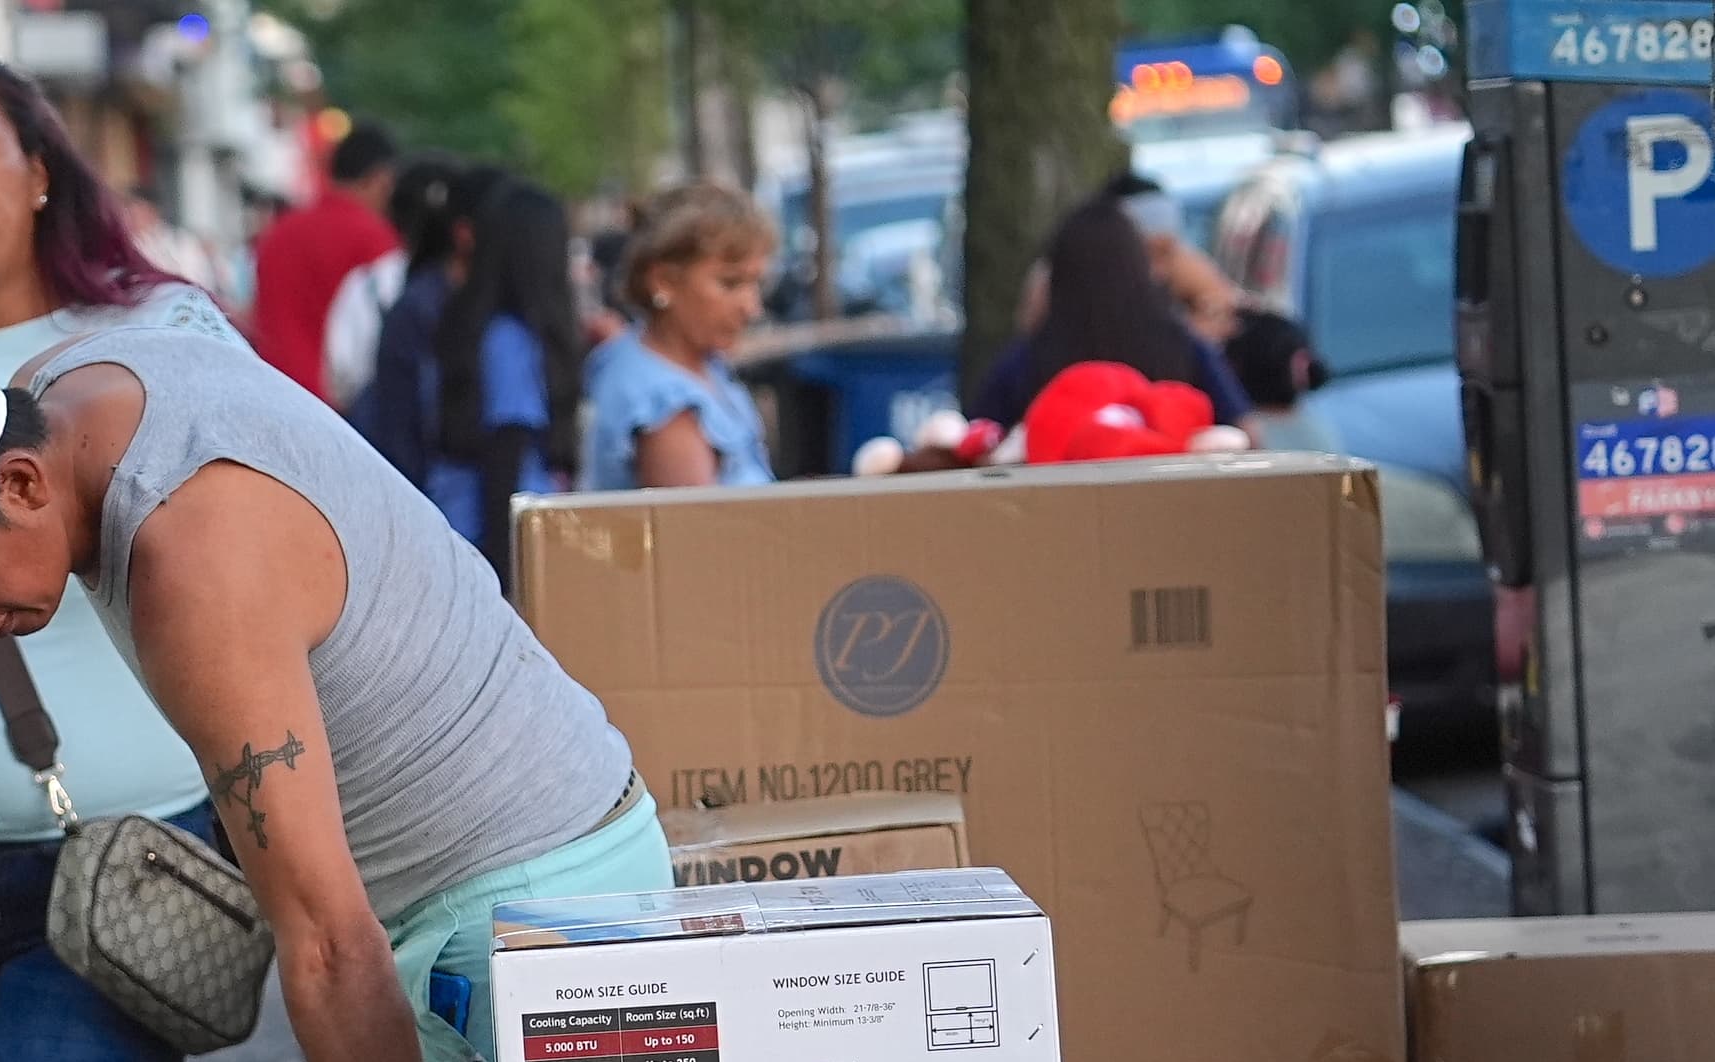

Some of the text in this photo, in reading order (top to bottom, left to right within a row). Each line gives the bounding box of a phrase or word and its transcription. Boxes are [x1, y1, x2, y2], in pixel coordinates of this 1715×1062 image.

[1551, 19, 1713, 65] 467828
[1626, 113, 1713, 252] P
[893, 756, 972, 793] GREY
[772, 970, 905, 988] WINDOW SIZE GUIDE
[556, 982, 667, 1000] ROOM SIZE GUIDE
[529, 1014, 612, 1028] Cooling Capacity
[625, 1007, 709, 1022] Room Size (sq.ft)
[545, 1040, 597, 1053] 5,000 BTU
[644, 1033, 694, 1048] Up to 150
